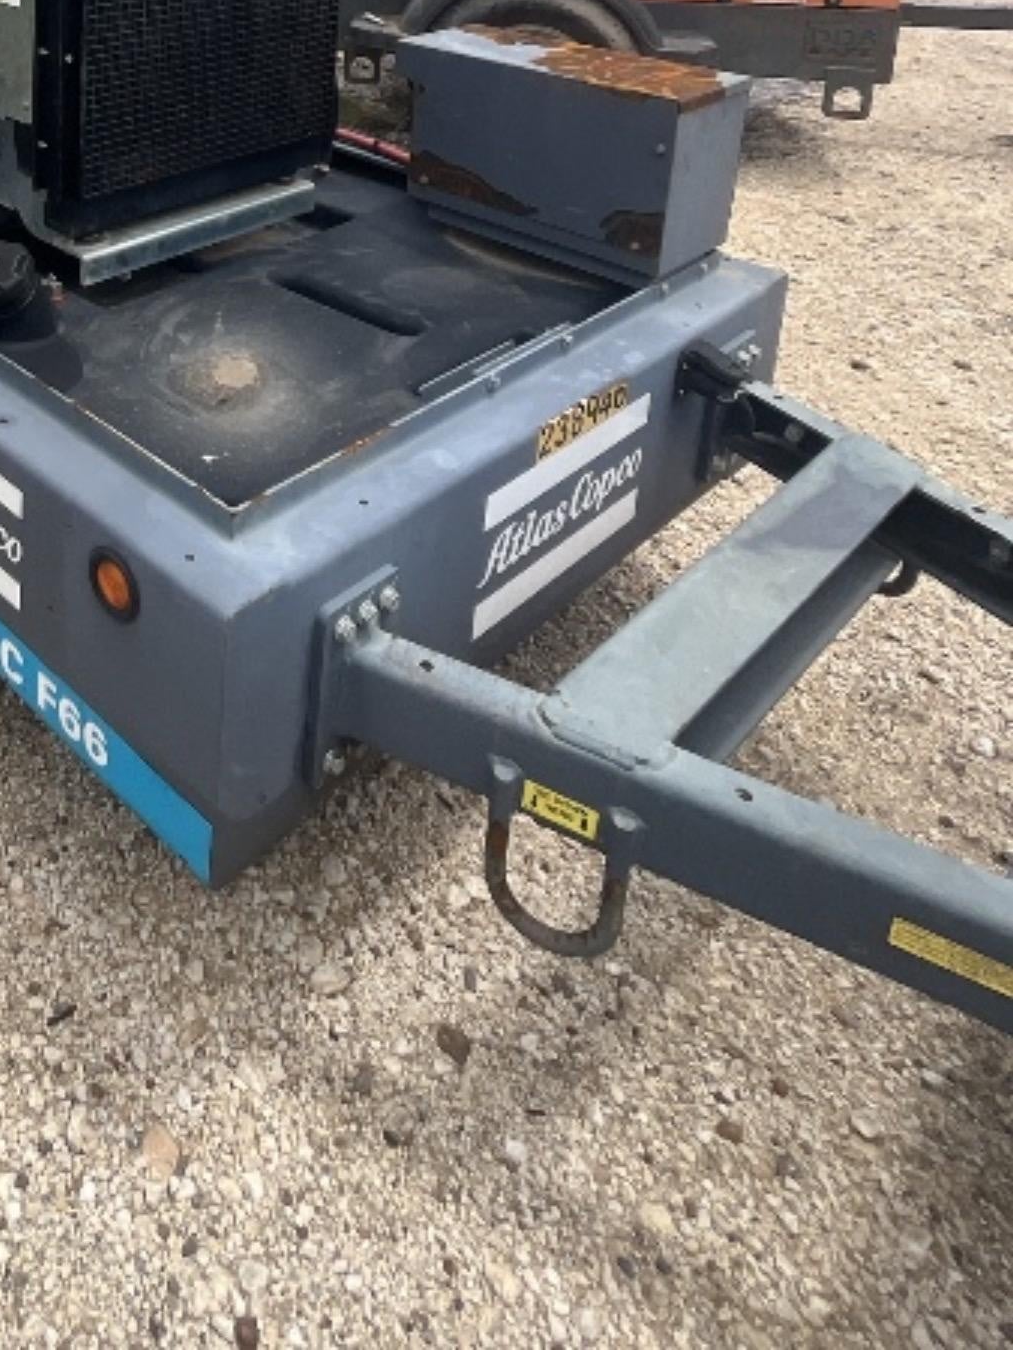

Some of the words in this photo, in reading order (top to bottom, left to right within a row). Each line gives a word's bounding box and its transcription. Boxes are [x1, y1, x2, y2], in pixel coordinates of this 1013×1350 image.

[475, 500, 568, 589] Atlas
[569, 446, 643, 520] Copco
[37, 670, 109, 767] F66
